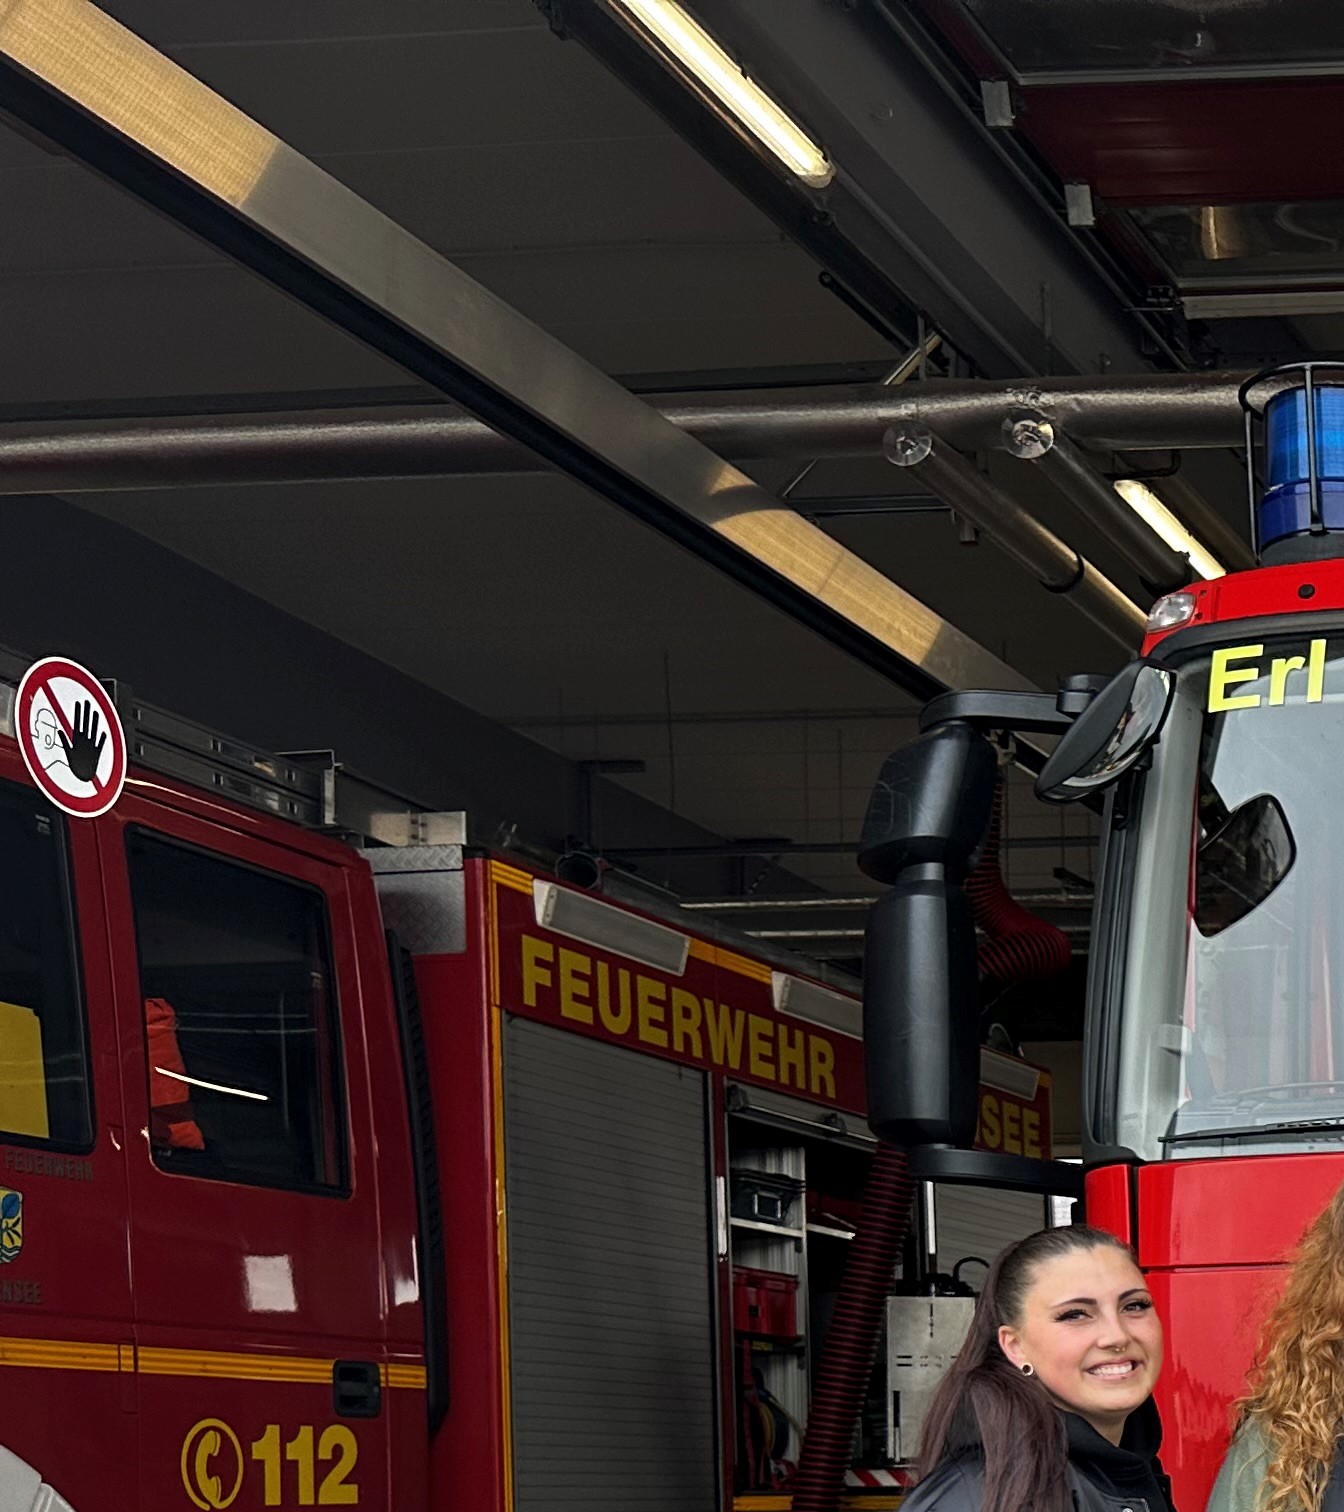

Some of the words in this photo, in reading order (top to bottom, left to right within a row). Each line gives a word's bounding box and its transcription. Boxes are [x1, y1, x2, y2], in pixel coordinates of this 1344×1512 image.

[1207, 639, 1326, 713] Erl
[521, 934, 837, 1099] FEUERWEHR
[975, 1098, 1041, 1158] SEE
[5, 1150, 95, 1182] FEUERWEHR
[251, 1424, 359, 1506] 112
